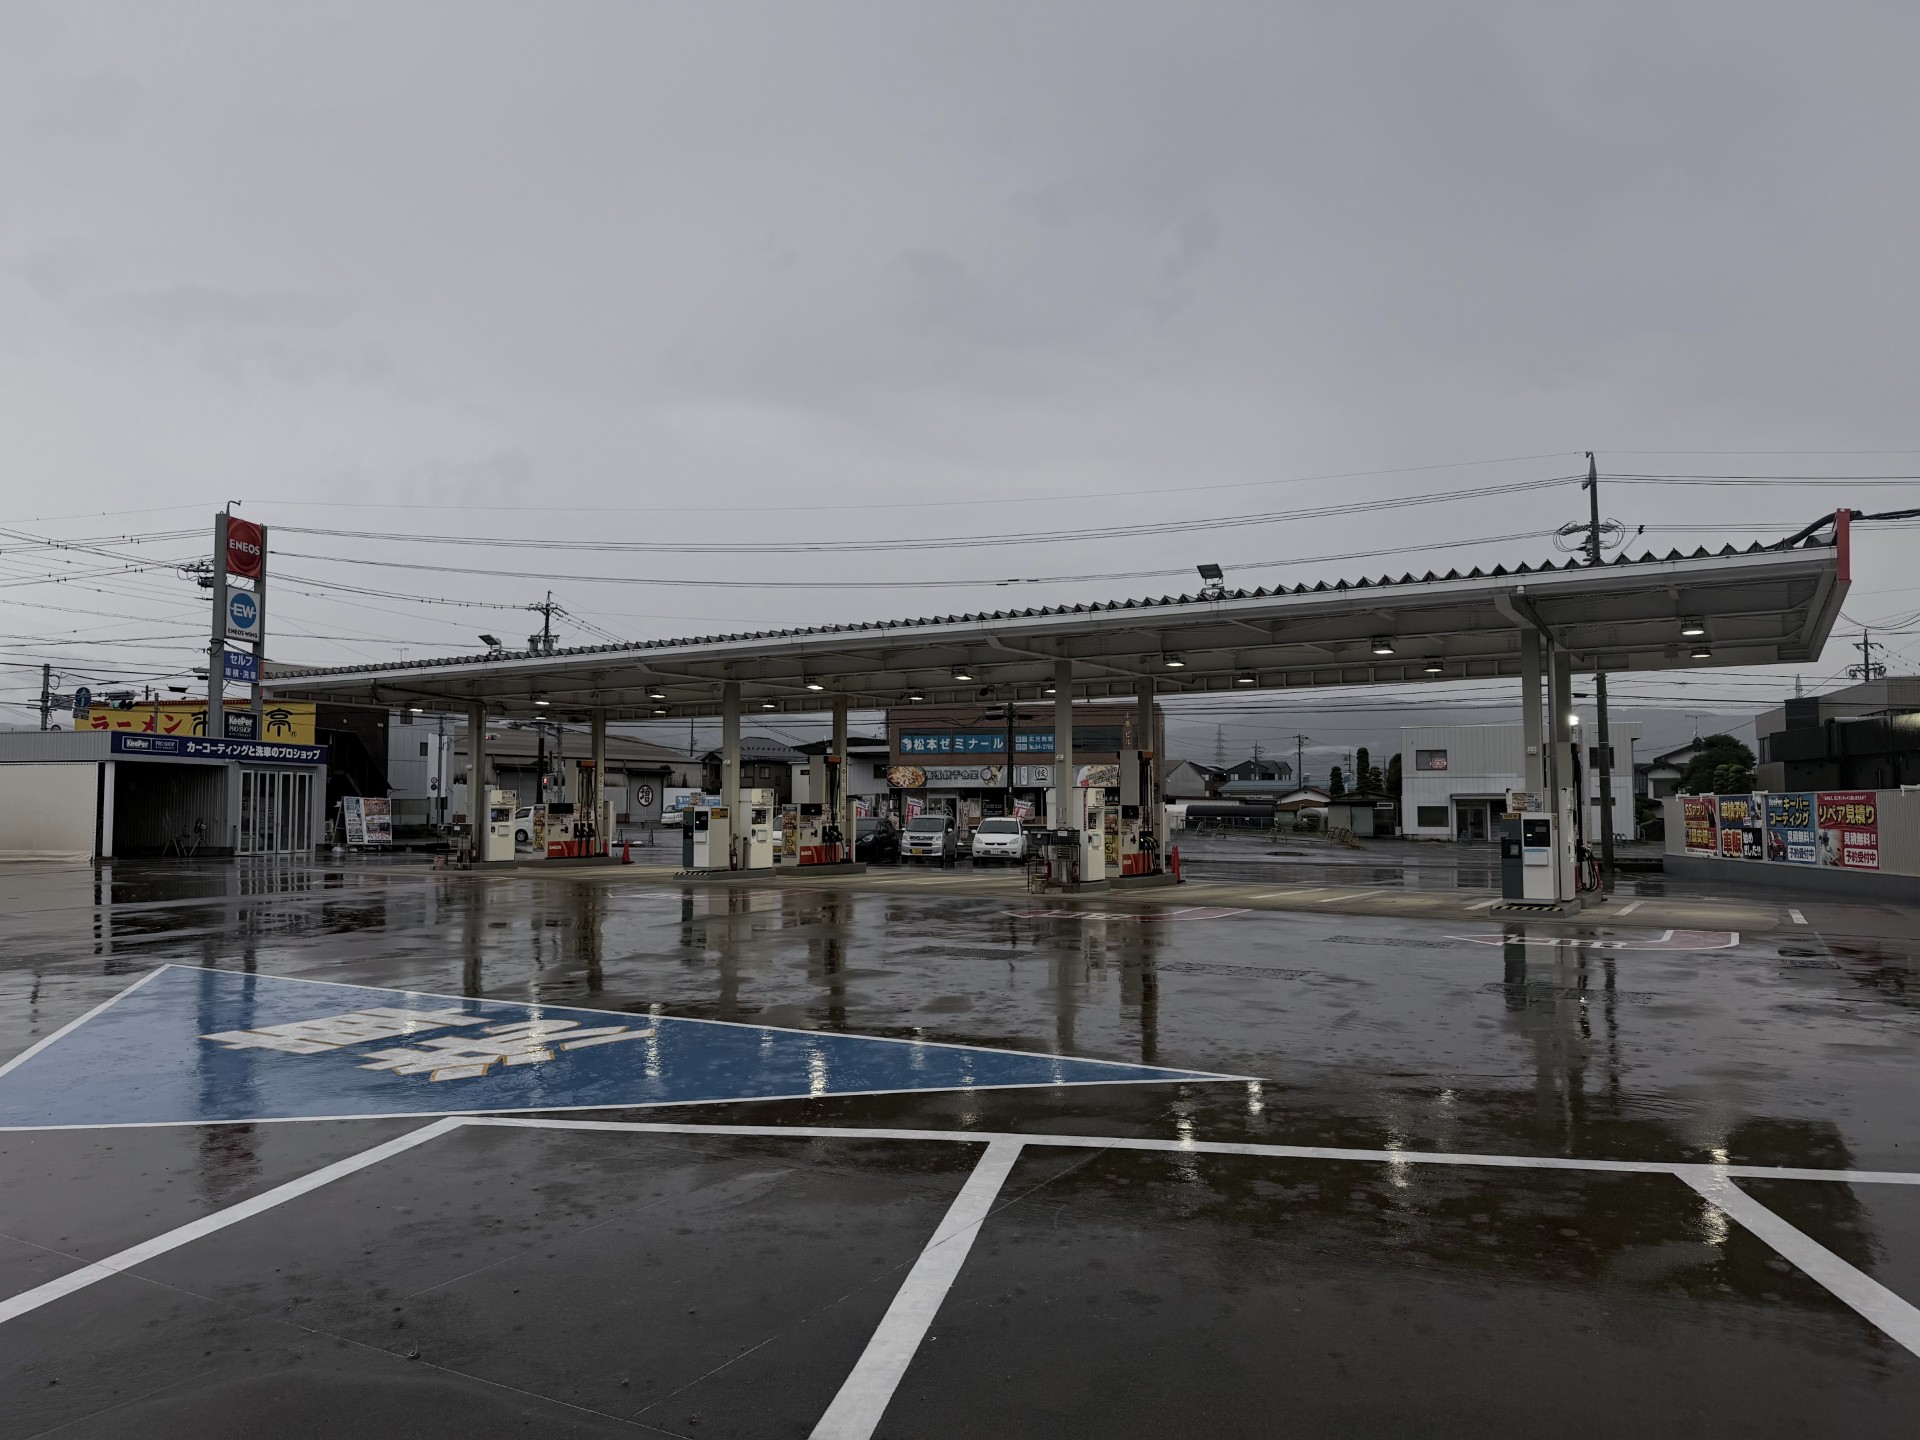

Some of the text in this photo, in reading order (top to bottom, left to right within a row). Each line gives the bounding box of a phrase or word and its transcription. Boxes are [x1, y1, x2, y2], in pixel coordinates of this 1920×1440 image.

[229, 538, 261, 556] ENEOS
[228, 628, 244, 636] ENEOS
[230, 653, 253, 667] セルフ
[91, 714, 182, 734] ラーメン
[228, 715, 253, 726] KeePer
[126, 739, 149, 749] KeePer
[913, 737, 1004, 750] 松本ゼミナール
[640, 787, 651, 803] 増
[1685, 803, 1705, 816] SSアプリ
[1720, 800, 1748, 818] 車検予約
[1783, 796, 1810, 810] キーパー
[1769, 811, 1810, 827] コーティング
[1818, 803, 1875, 824] リペア見積り
[1789, 847, 1815, 860] 予約受付中
[1846, 850, 1876, 864] 予約受付中
